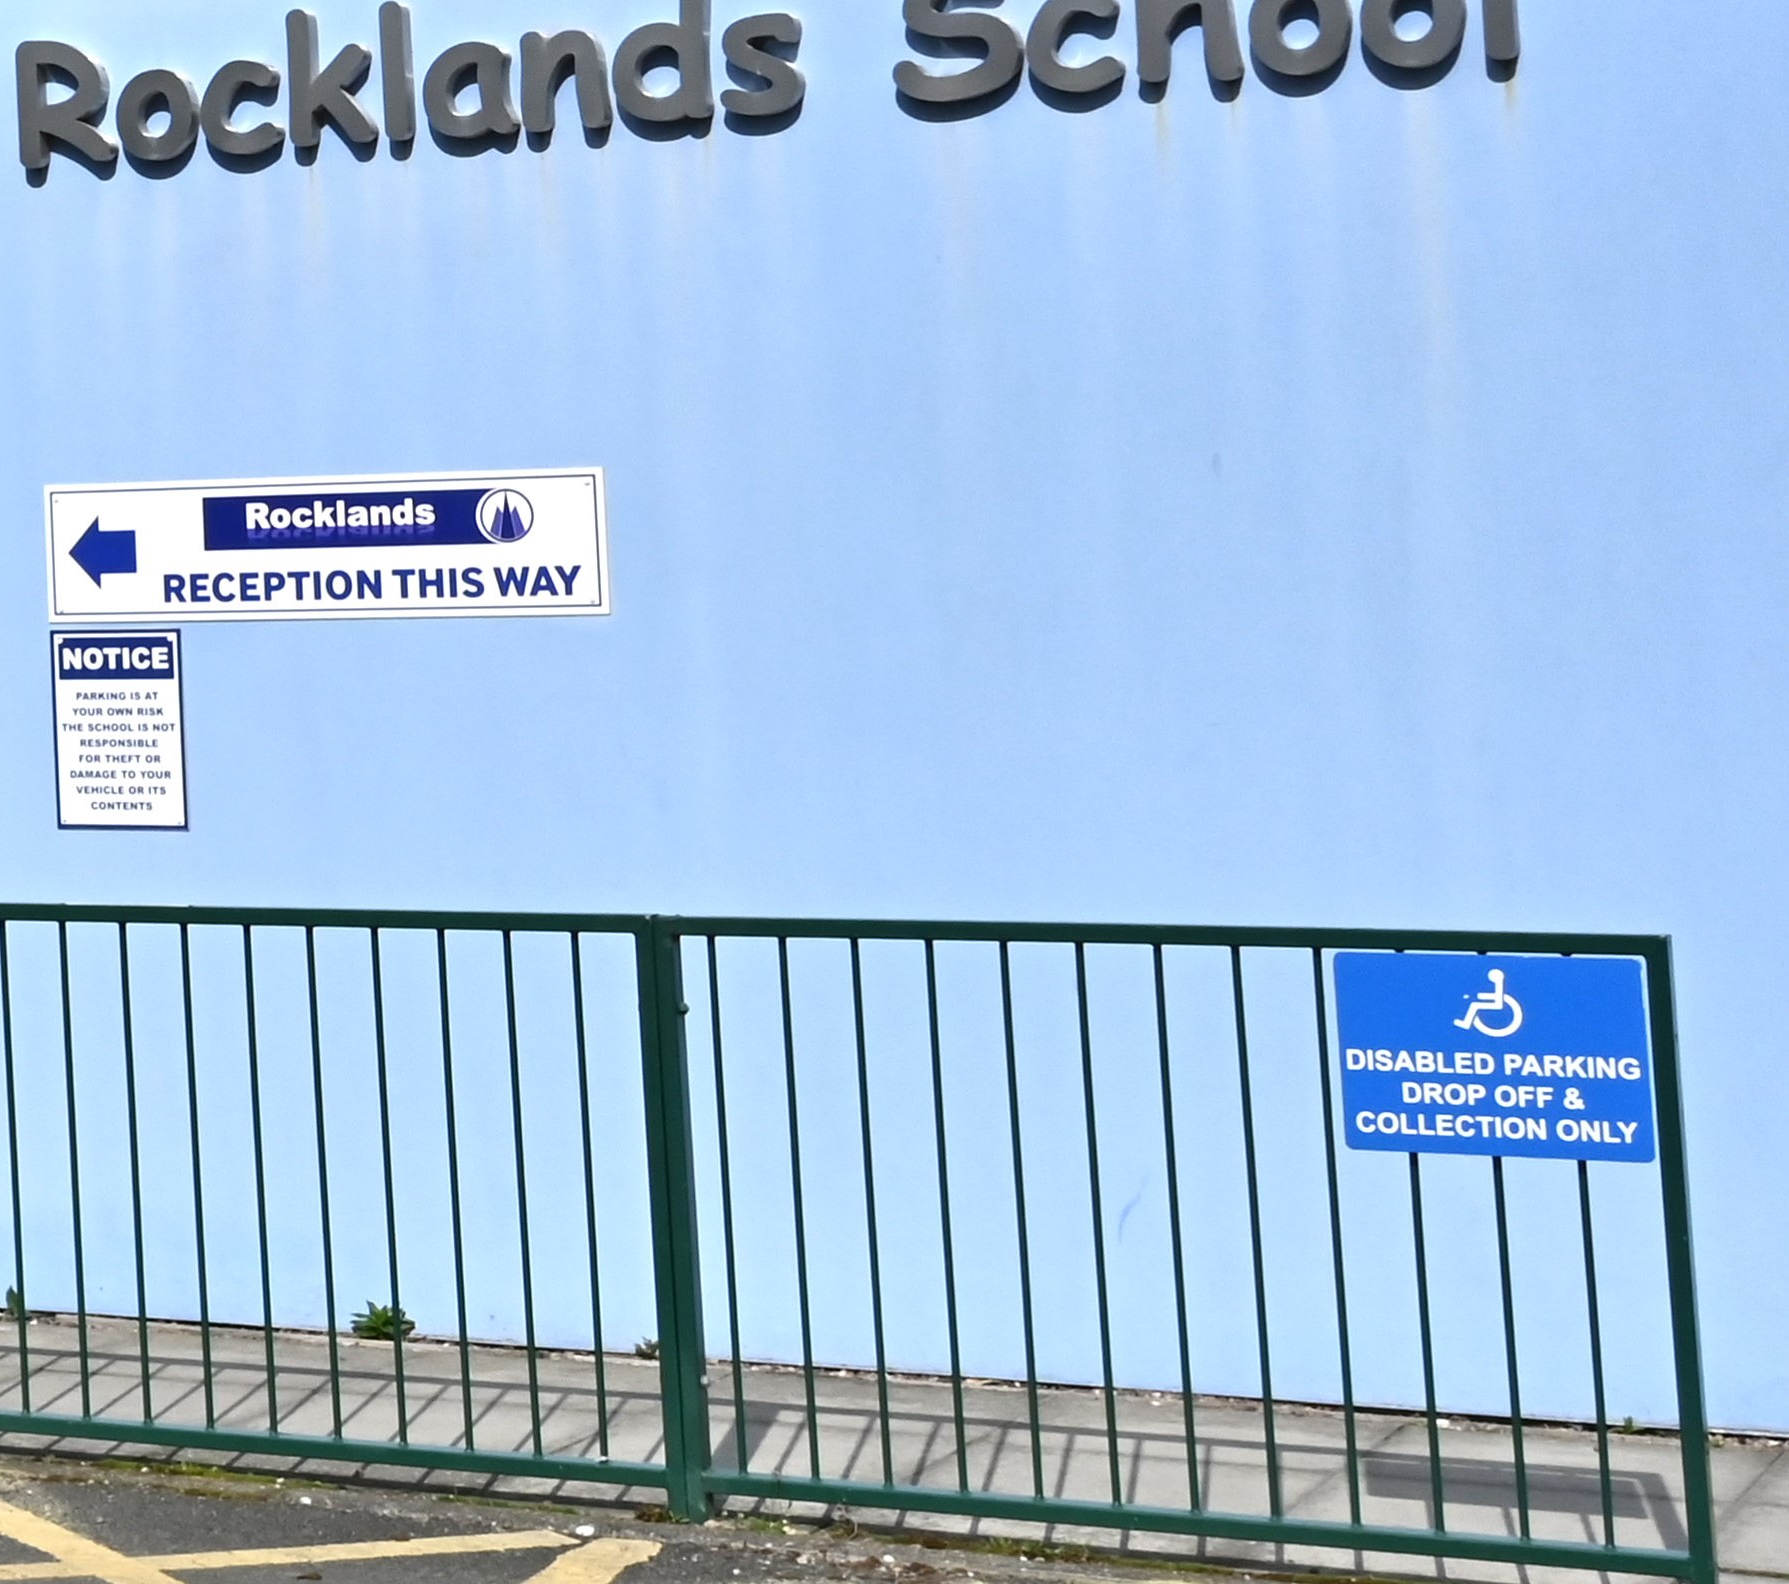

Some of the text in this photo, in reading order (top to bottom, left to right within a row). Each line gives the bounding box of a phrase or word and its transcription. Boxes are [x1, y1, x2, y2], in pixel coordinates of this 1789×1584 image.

[245, 498, 436, 530] Rocklands
[164, 565, 582, 604] RECEPTION THIS WAY
[62, 647, 170, 670] NOTICE
[76, 692, 158, 700] PARKING IS AT
[73, 708, 163, 716] YOUR OWN RISK
[88, 724, 134, 732] SCHOOL
[80, 739, 158, 747] RESPONSIBLE
[79, 755, 161, 763] FOR THEFT OR
[70, 771, 171, 779] DAMAGE TO YOUR
[76, 786, 124, 794] VEHICLE
[129, 786, 144, 794] OR
[91, 802, 152, 810] CONTENTS
[1346, 1048, 1641, 1080] DISABLED PARKING
[1402, 1082, 1585, 1109] DROP OFF &
[1355, 1111, 1638, 1144] COLLECTION ONLY
